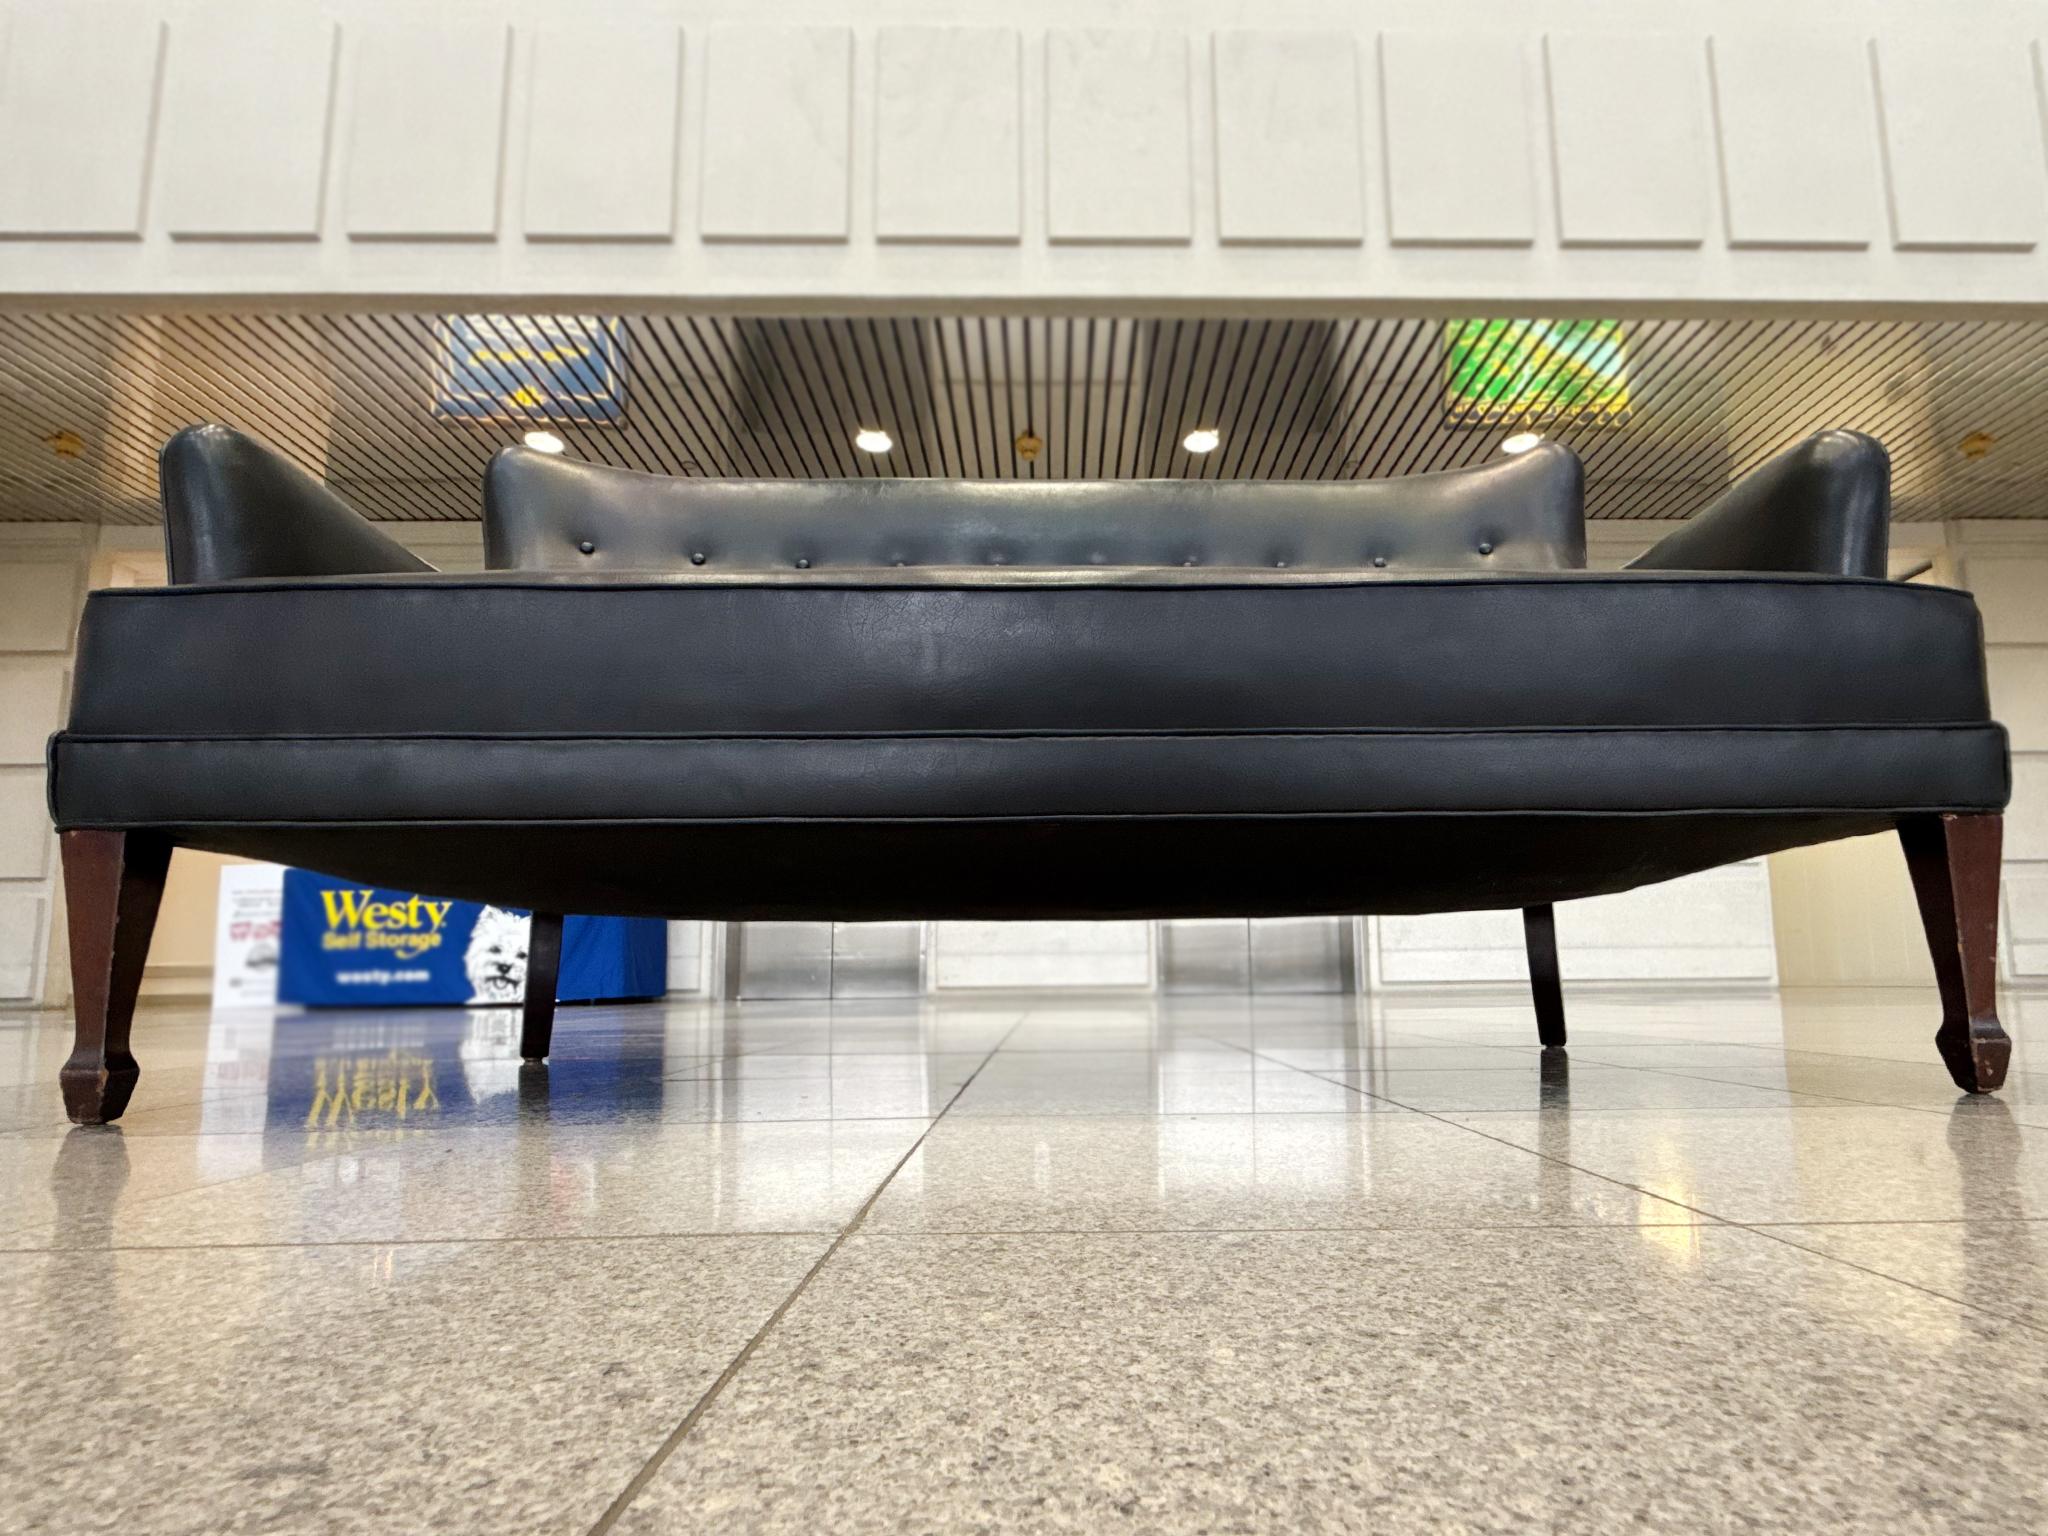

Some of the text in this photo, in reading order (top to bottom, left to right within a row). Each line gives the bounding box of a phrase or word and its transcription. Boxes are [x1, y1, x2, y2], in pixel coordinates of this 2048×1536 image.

[320, 890, 452, 933] Westy
[323, 931, 442, 959] Self Storage
[336, 969, 429, 986] westy.com
